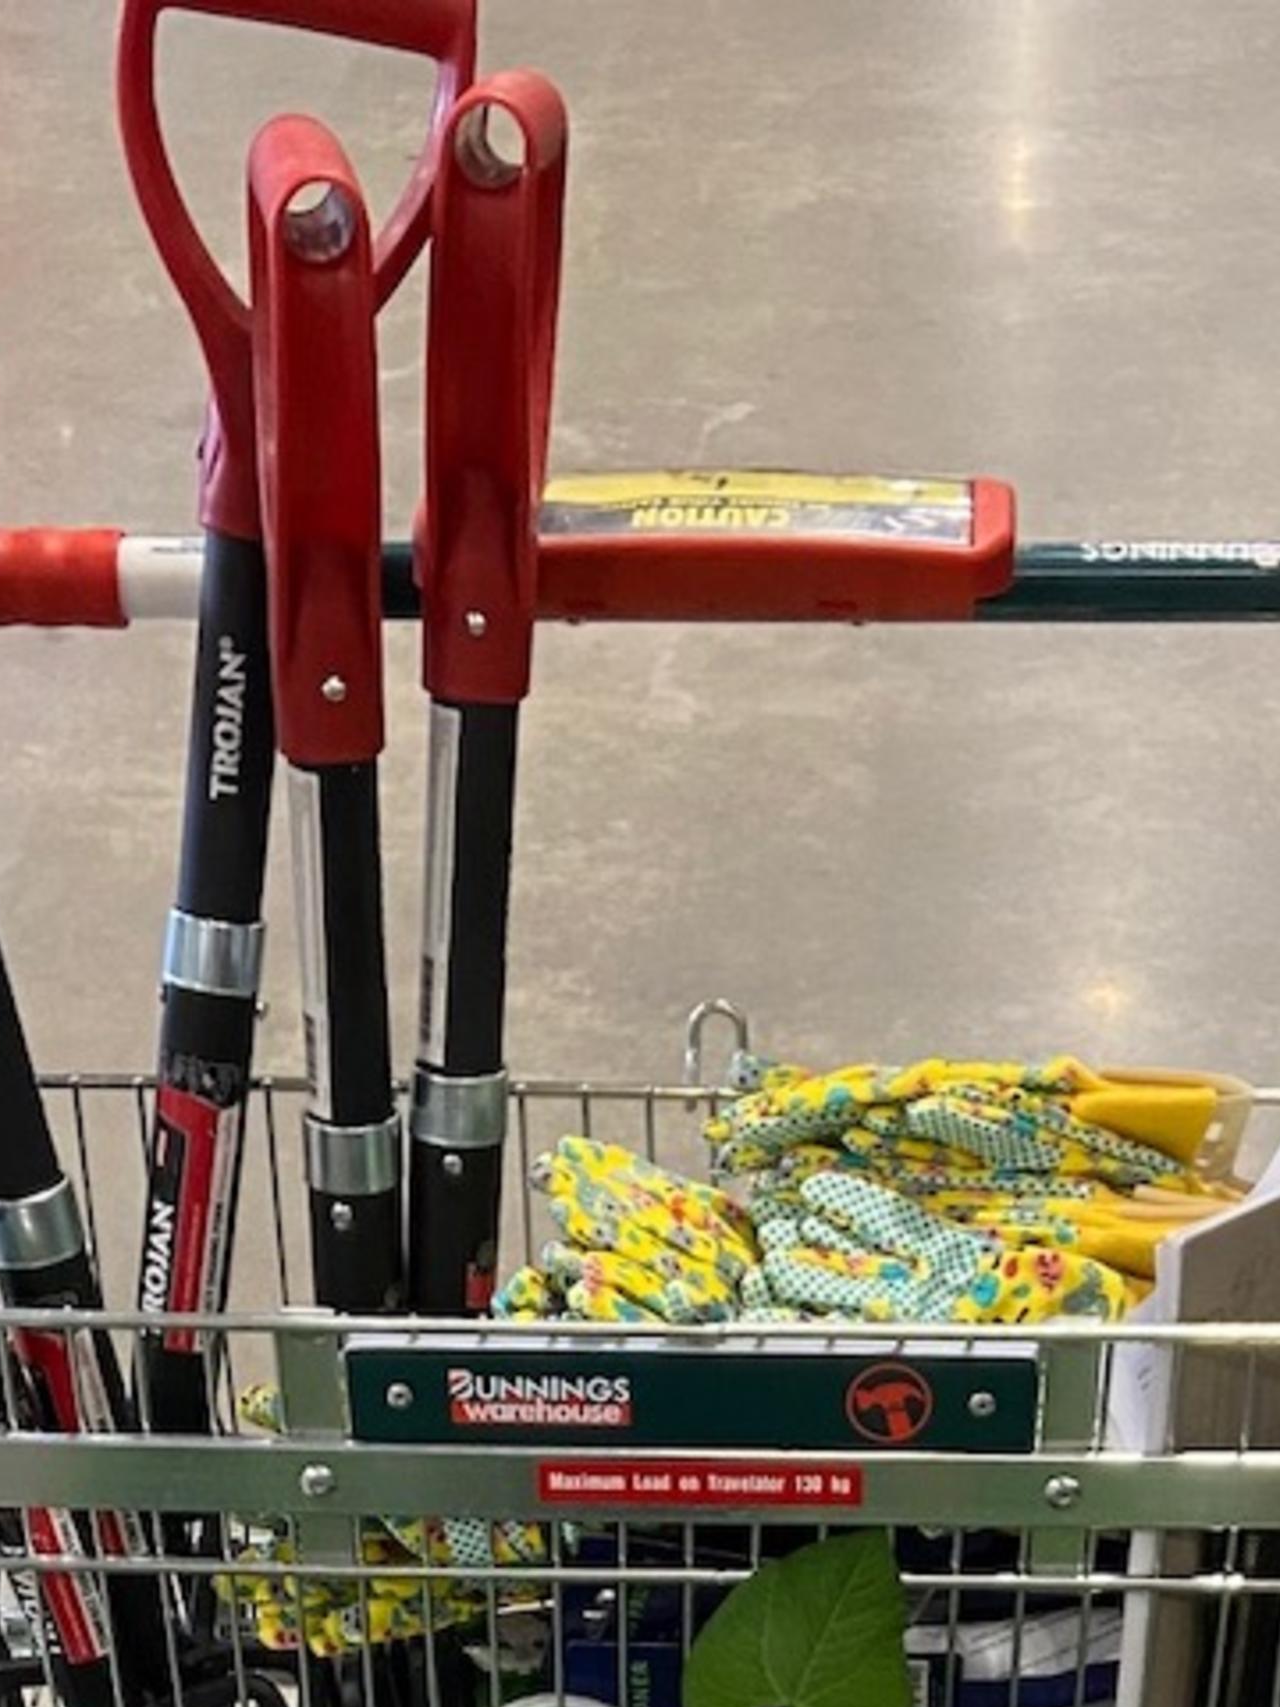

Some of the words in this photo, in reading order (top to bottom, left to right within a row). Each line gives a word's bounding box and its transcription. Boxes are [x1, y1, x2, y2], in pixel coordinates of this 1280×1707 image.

[631, 505, 789, 529] CAUTION
[210, 651, 249, 801] TROJAN
[139, 1200, 175, 1337] ROJAN
[447, 1368, 631, 1401] BUNNINGS
[463, 1400, 621, 1424] warehouse
[548, 1471, 626, 1491] Maximum
[632, 1472, 671, 1492] Load
[678, 1475, 700, 1492] on
[707, 1473, 786, 1493] Travelator
[830, 1475, 852, 1496] kg
